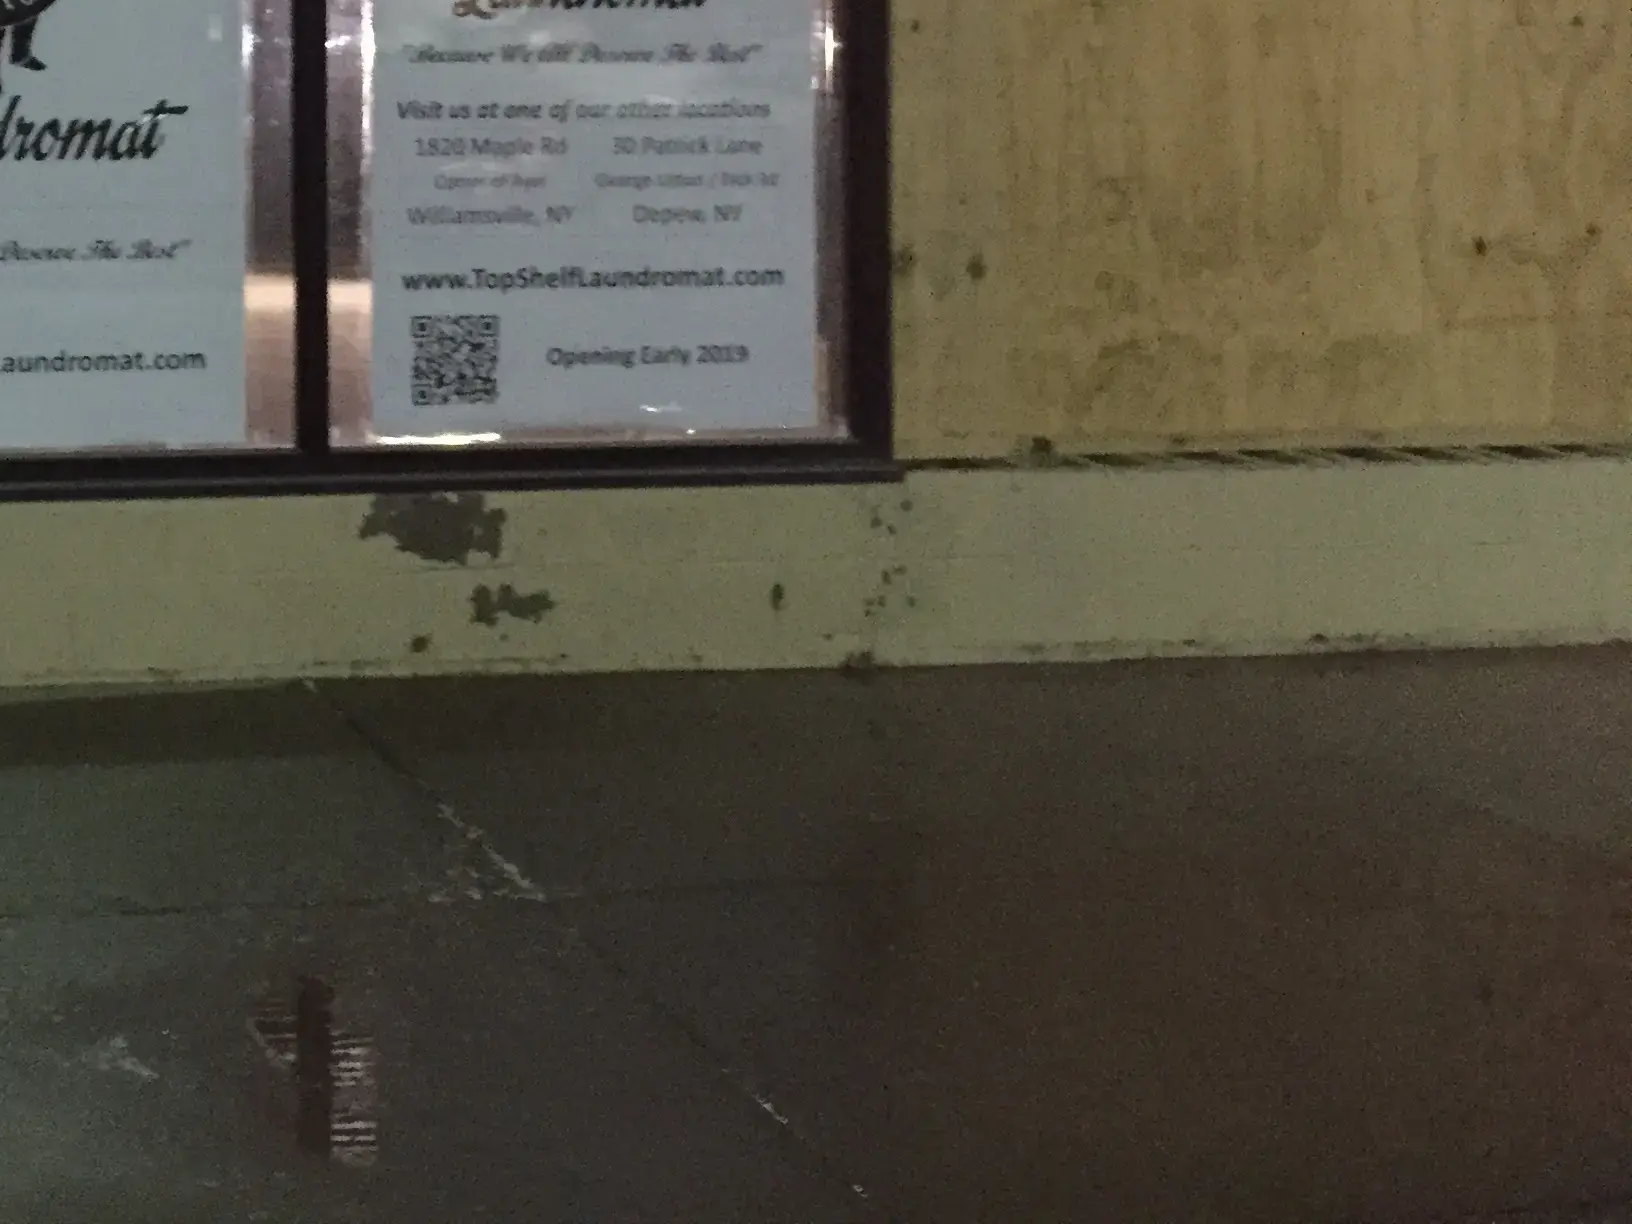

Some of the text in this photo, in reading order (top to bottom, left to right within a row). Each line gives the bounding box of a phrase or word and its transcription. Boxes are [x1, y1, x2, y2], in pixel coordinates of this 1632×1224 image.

[396, 101, 443, 120] Visit
[448, 104, 472, 120] us
[476, 102, 499, 120] at
[503, 104, 542, 120] one
[402, 265, 786, 295] www.TopShelfLaundromat.com
[546, 345, 637, 369] Opening
[640, 344, 692, 366] Early
